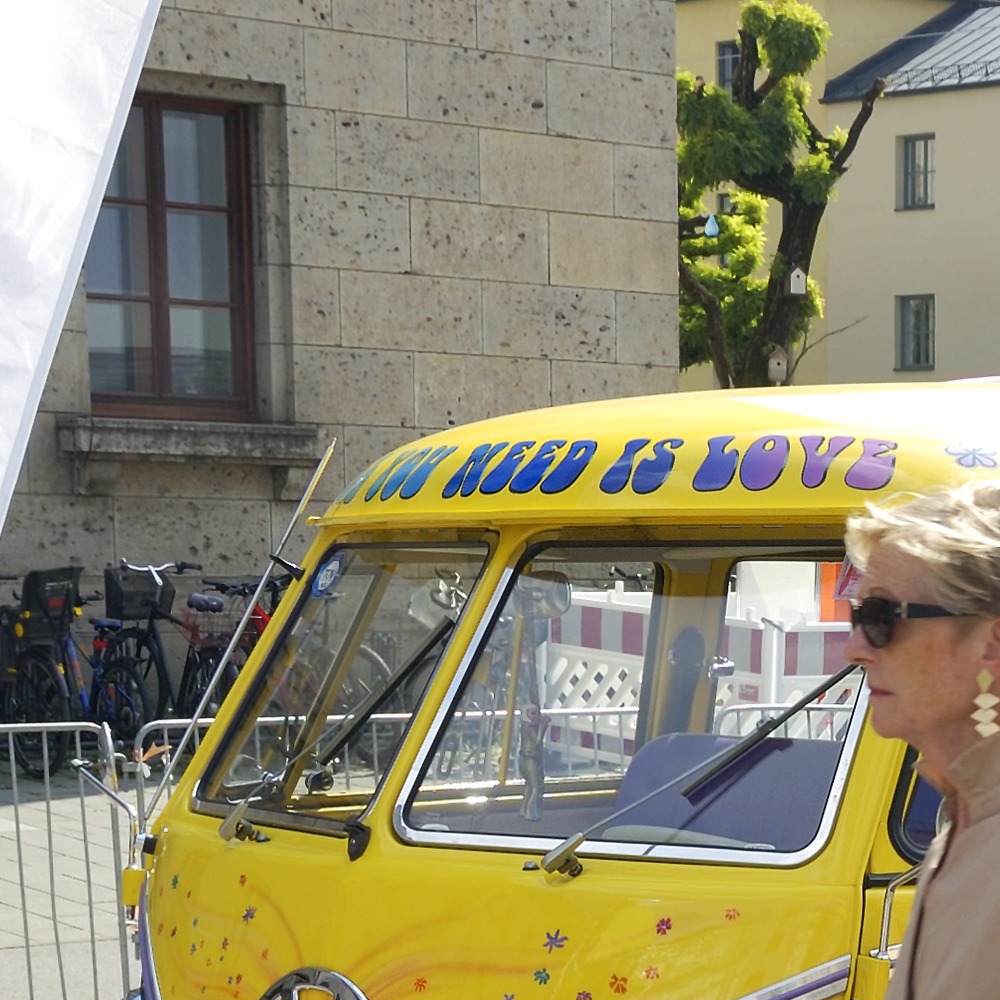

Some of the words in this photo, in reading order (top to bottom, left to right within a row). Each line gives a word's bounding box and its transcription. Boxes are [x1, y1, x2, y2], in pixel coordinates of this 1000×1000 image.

[364, 446, 459, 502] YOU
[442, 439, 597, 498] NEED
[599, 438, 683, 495] IS
[692, 434, 898, 492] LOVE
